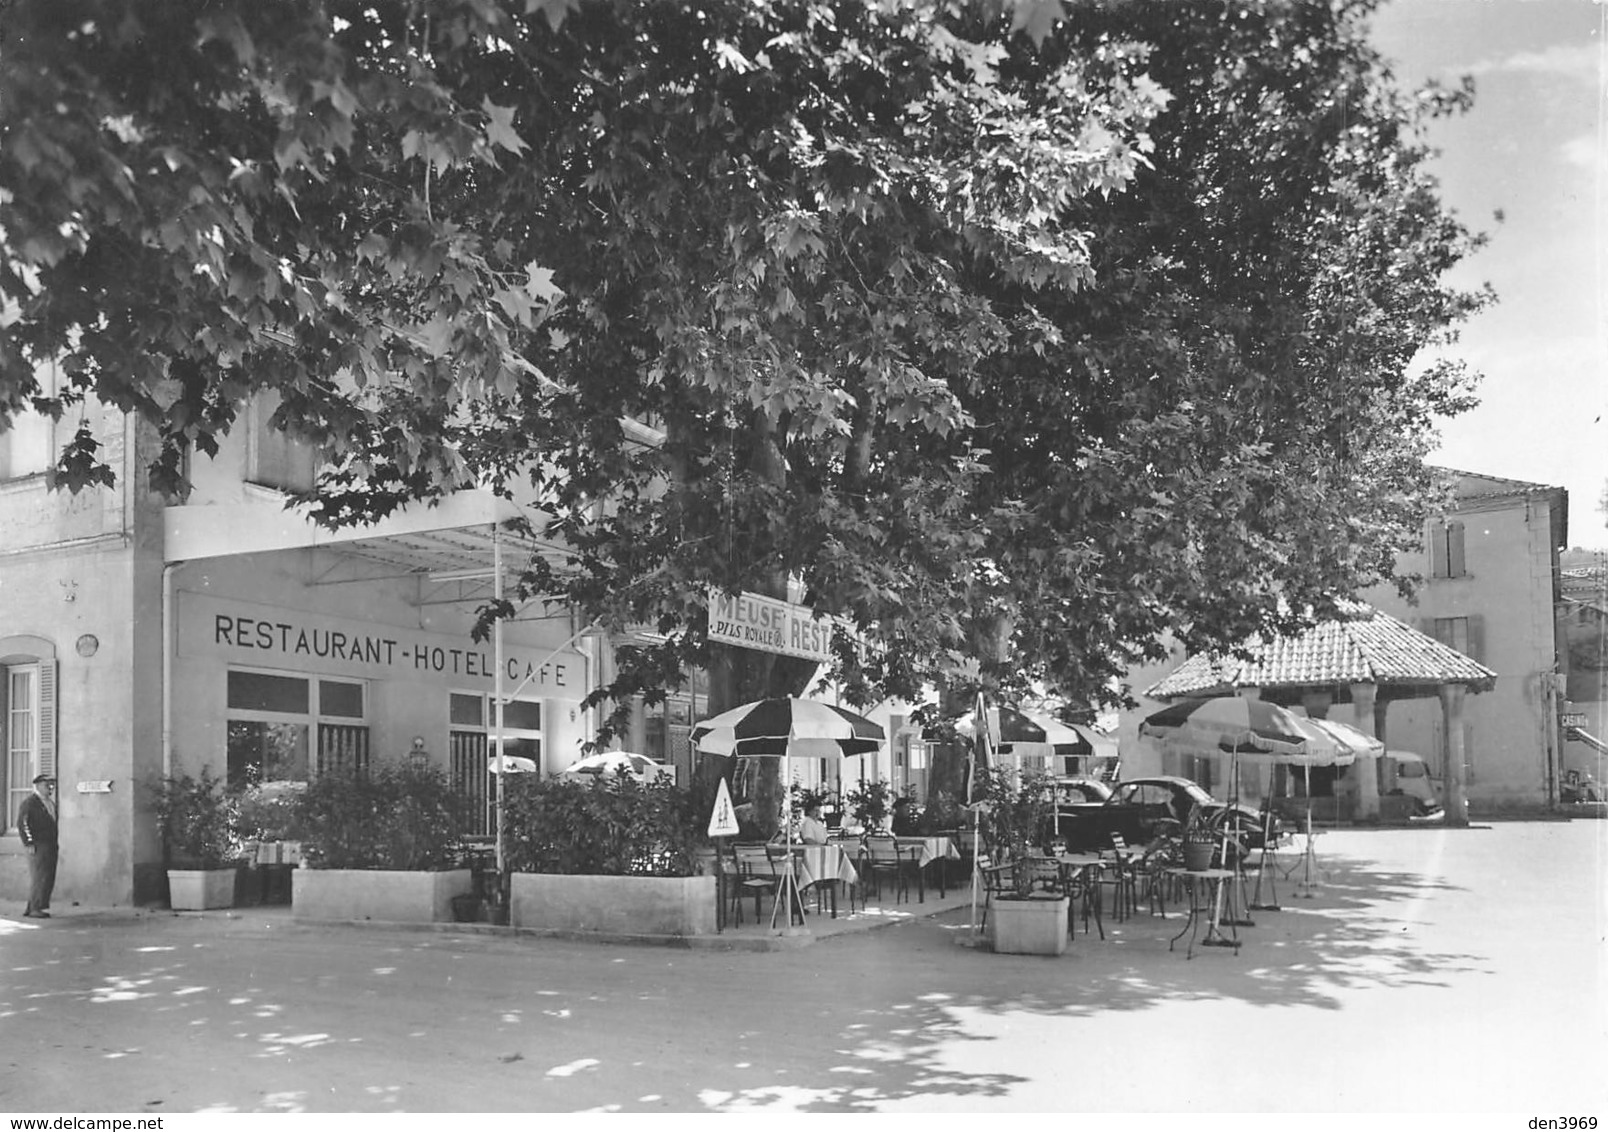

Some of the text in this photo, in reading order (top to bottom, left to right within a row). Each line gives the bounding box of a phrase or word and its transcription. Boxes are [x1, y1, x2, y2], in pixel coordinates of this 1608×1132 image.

[717, 595, 781, 630] MEUSE
[716, 621, 773, 646] PILS ROYALE
[791, 617, 832, 655] REST
[507, 657, 566, 687] CAFE
